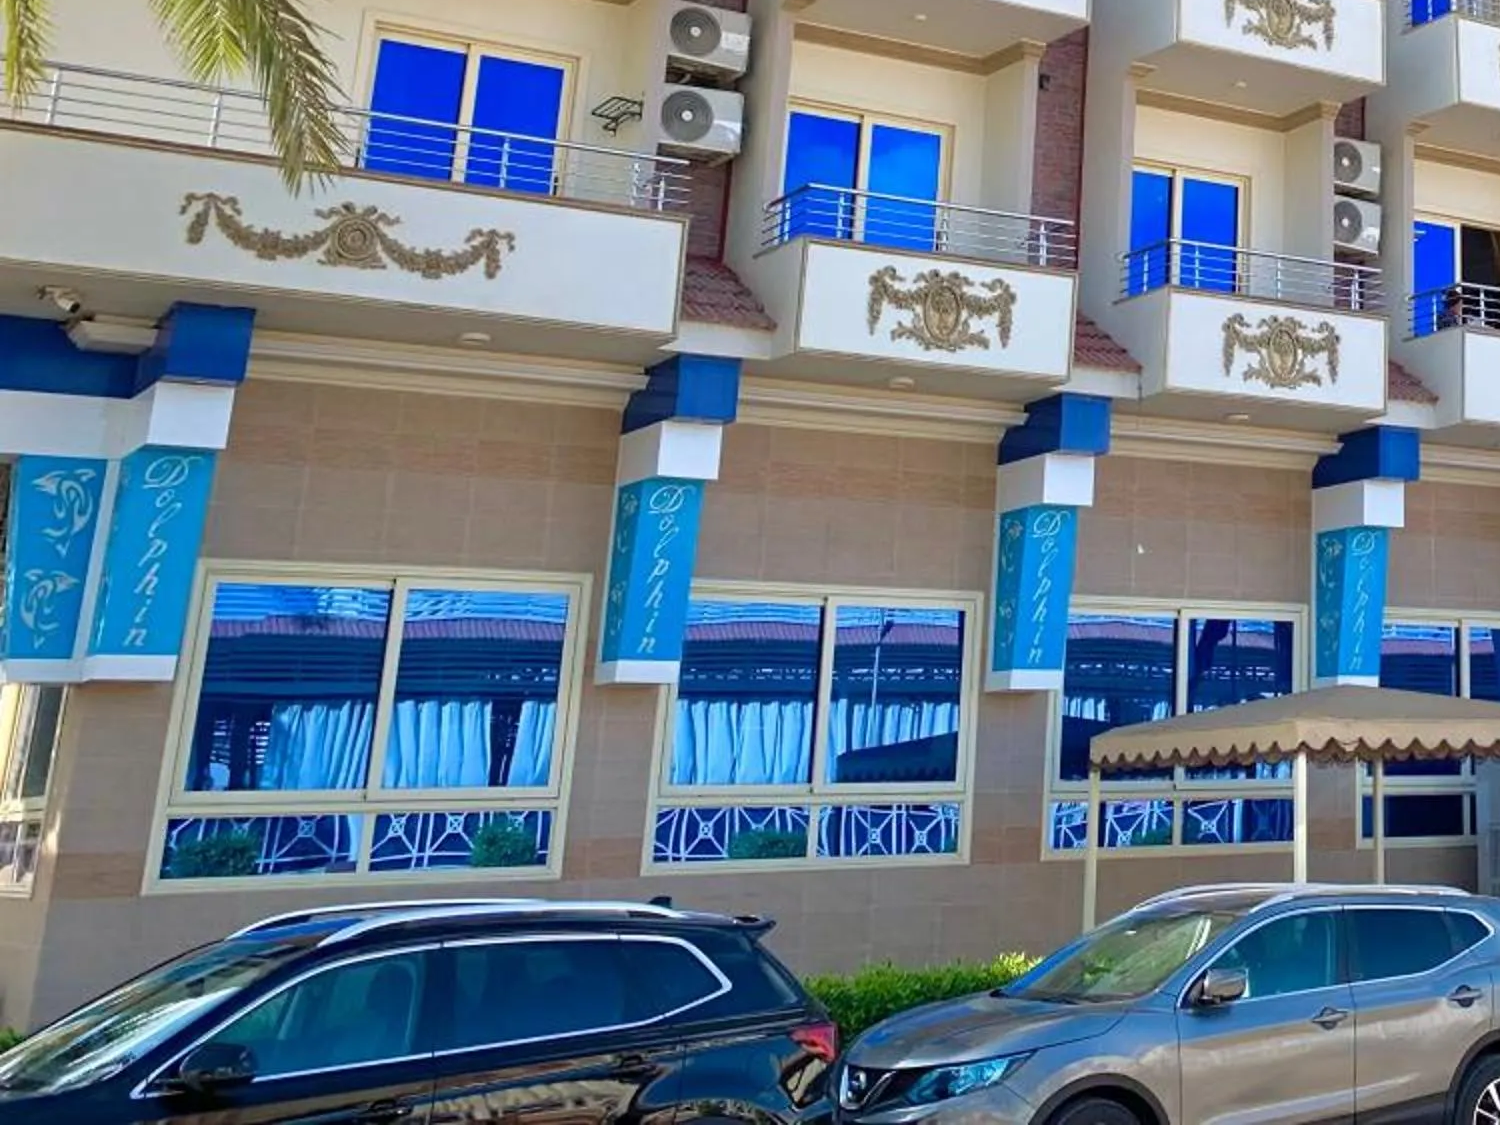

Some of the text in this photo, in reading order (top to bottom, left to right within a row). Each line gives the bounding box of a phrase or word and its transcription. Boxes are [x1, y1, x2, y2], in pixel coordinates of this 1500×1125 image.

[123, 455, 205, 646] Dolphin
[637, 484, 697, 653] Dolphin
[1028, 509, 1071, 664] Dolphin
